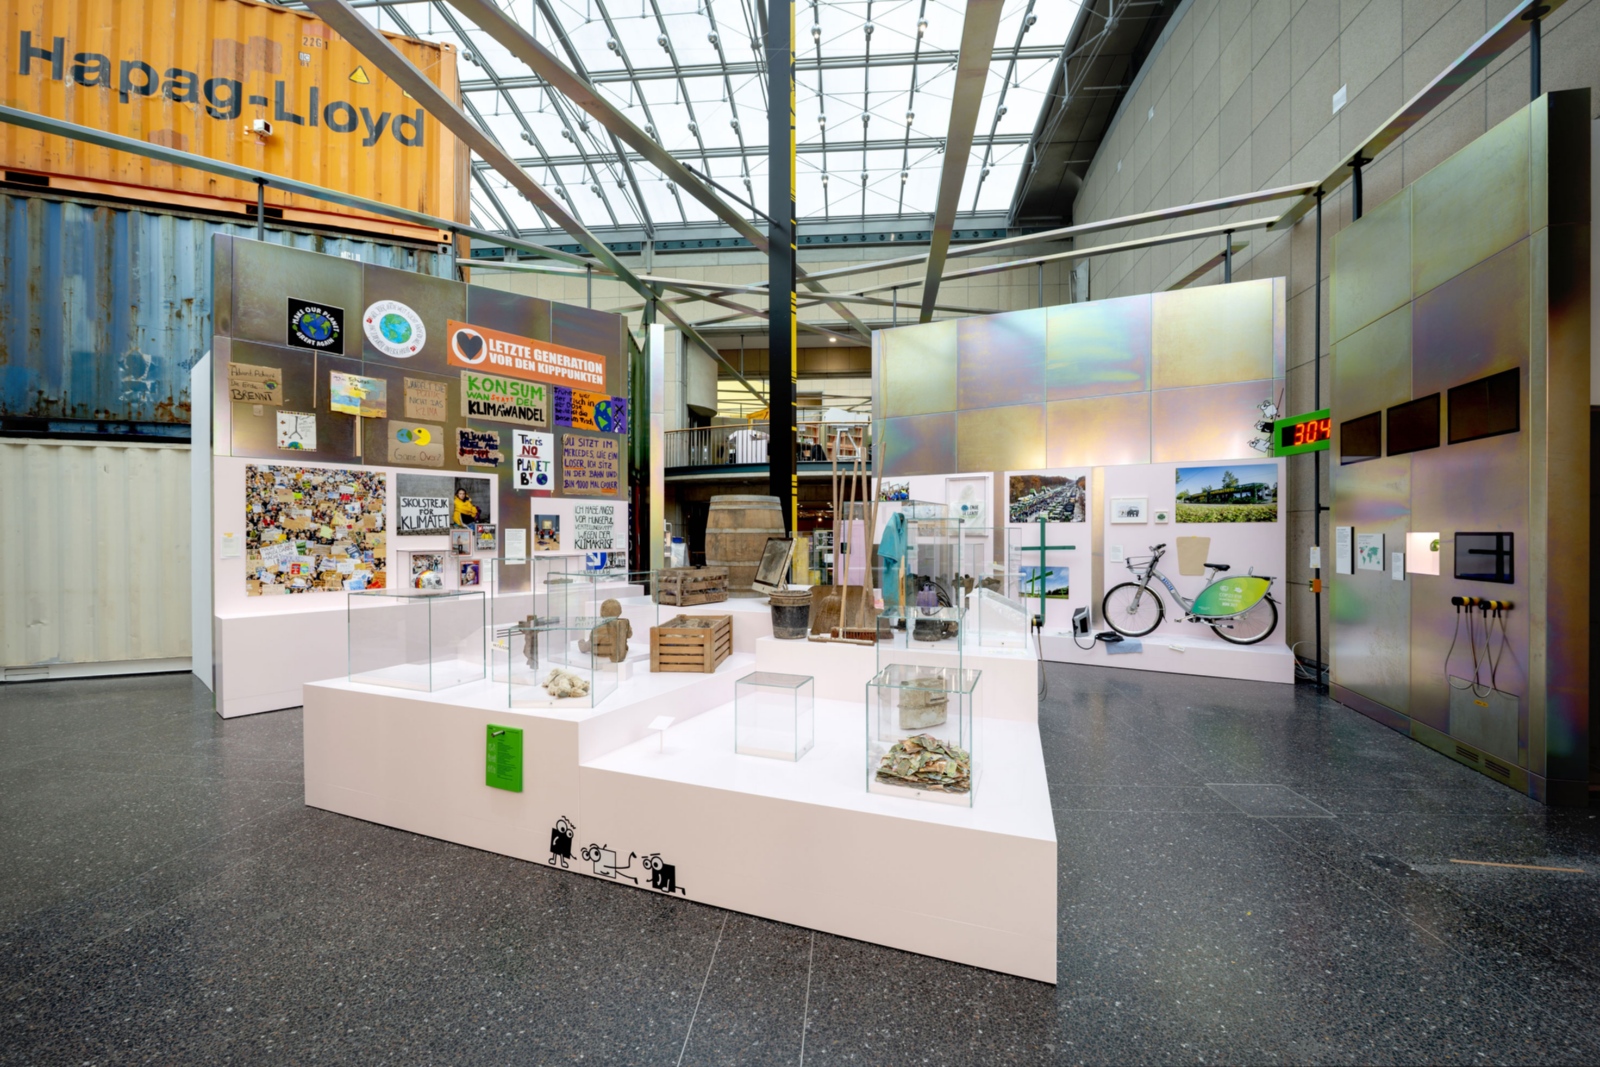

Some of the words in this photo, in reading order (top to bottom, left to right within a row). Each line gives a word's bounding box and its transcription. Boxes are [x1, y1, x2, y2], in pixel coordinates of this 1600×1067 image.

[19, 31, 424, 147] Hapag-Lloyd
[292, 308, 305, 325] MAKE
[322, 310, 340, 332] PLANET
[296, 332, 316, 346] GREAT
[316, 338, 334, 346] AGAIN
[489, 338, 531, 359] LETZTE
[534, 348, 602, 374] GENERATION
[489, 352, 512, 367] VOR
[515, 358, 536, 372] DEN
[538, 362, 602, 385] KIPPPUNKTEN
[230, 388, 272, 401] BRENNT
[466, 391, 490, 401] WAN
[491, 394, 514, 402] STATT
[516, 398, 536, 407] DEL
[468, 400, 544, 422] KLIMAWANDEL
[1294, 418, 1332, 446] 304
[578, 438, 599, 448] SITZT
[602, 440, 612, 448] IM
[394, 448, 416, 461] Game
[522, 445, 538, 456] NO
[608, 452, 618, 460] EIN
[516, 458, 551, 472] PLANET
[588, 460, 596, 468] ICH
[564, 480, 574, 488] BIN
[576, 480, 588, 489] 1000
[590, 480, 600, 488] MAL
[600, 480, 618, 489] COOLER
[402, 498, 448, 508] SKOLSTREJK
[401, 514, 449, 530] KLIMATET
[574, 515, 586, 524] VOR
[599, 530, 610, 538] DER
[574, 538, 614, 550] KLIMAKRISE
